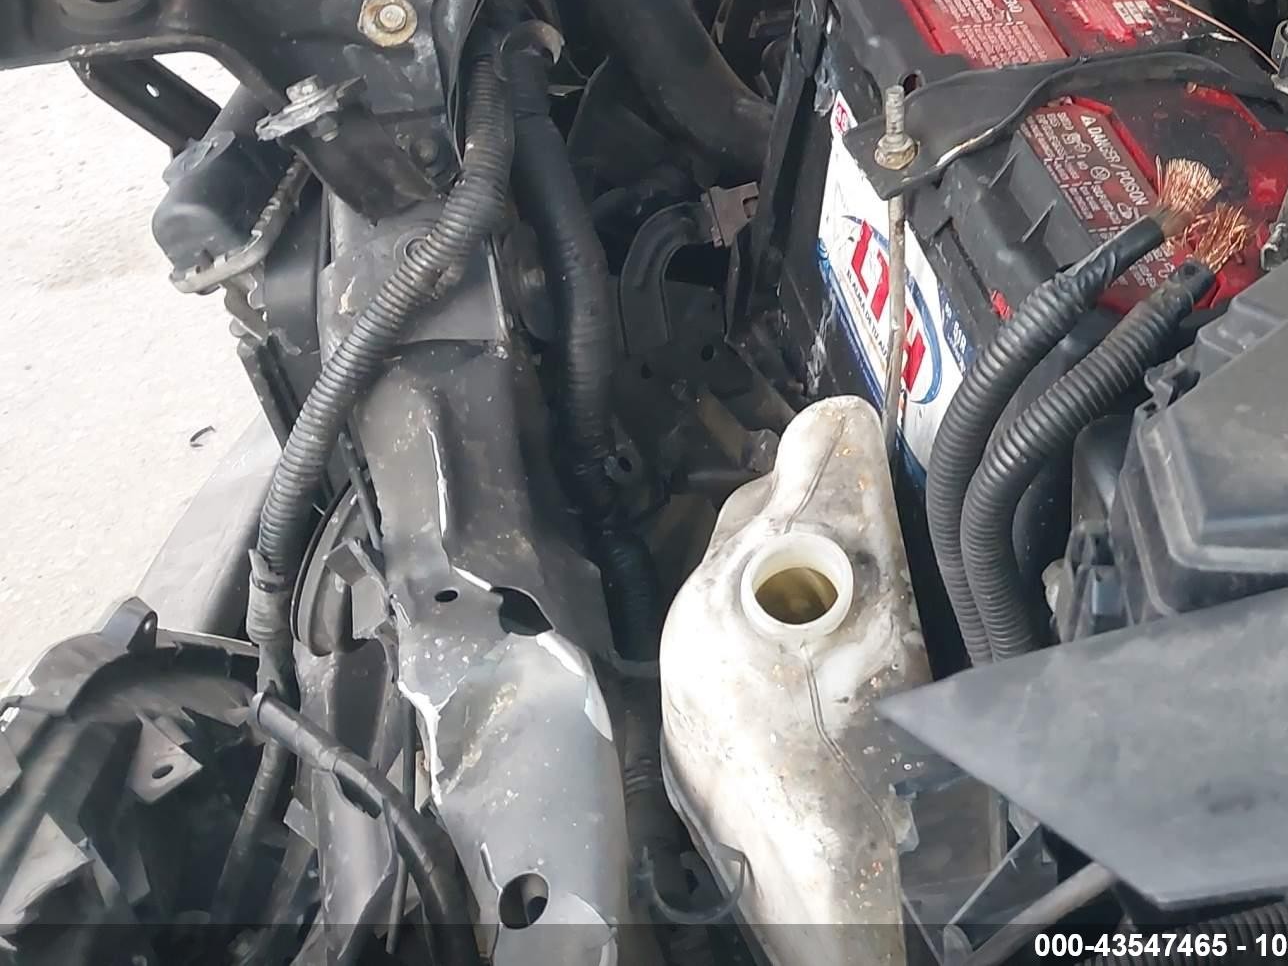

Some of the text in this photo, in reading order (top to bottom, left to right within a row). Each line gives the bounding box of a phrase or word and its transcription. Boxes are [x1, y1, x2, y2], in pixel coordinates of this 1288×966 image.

[1087, 126, 1121, 163] DANGER
[1116, 170, 1149, 206] POISON
[852, 282, 867, 309] ALMA
